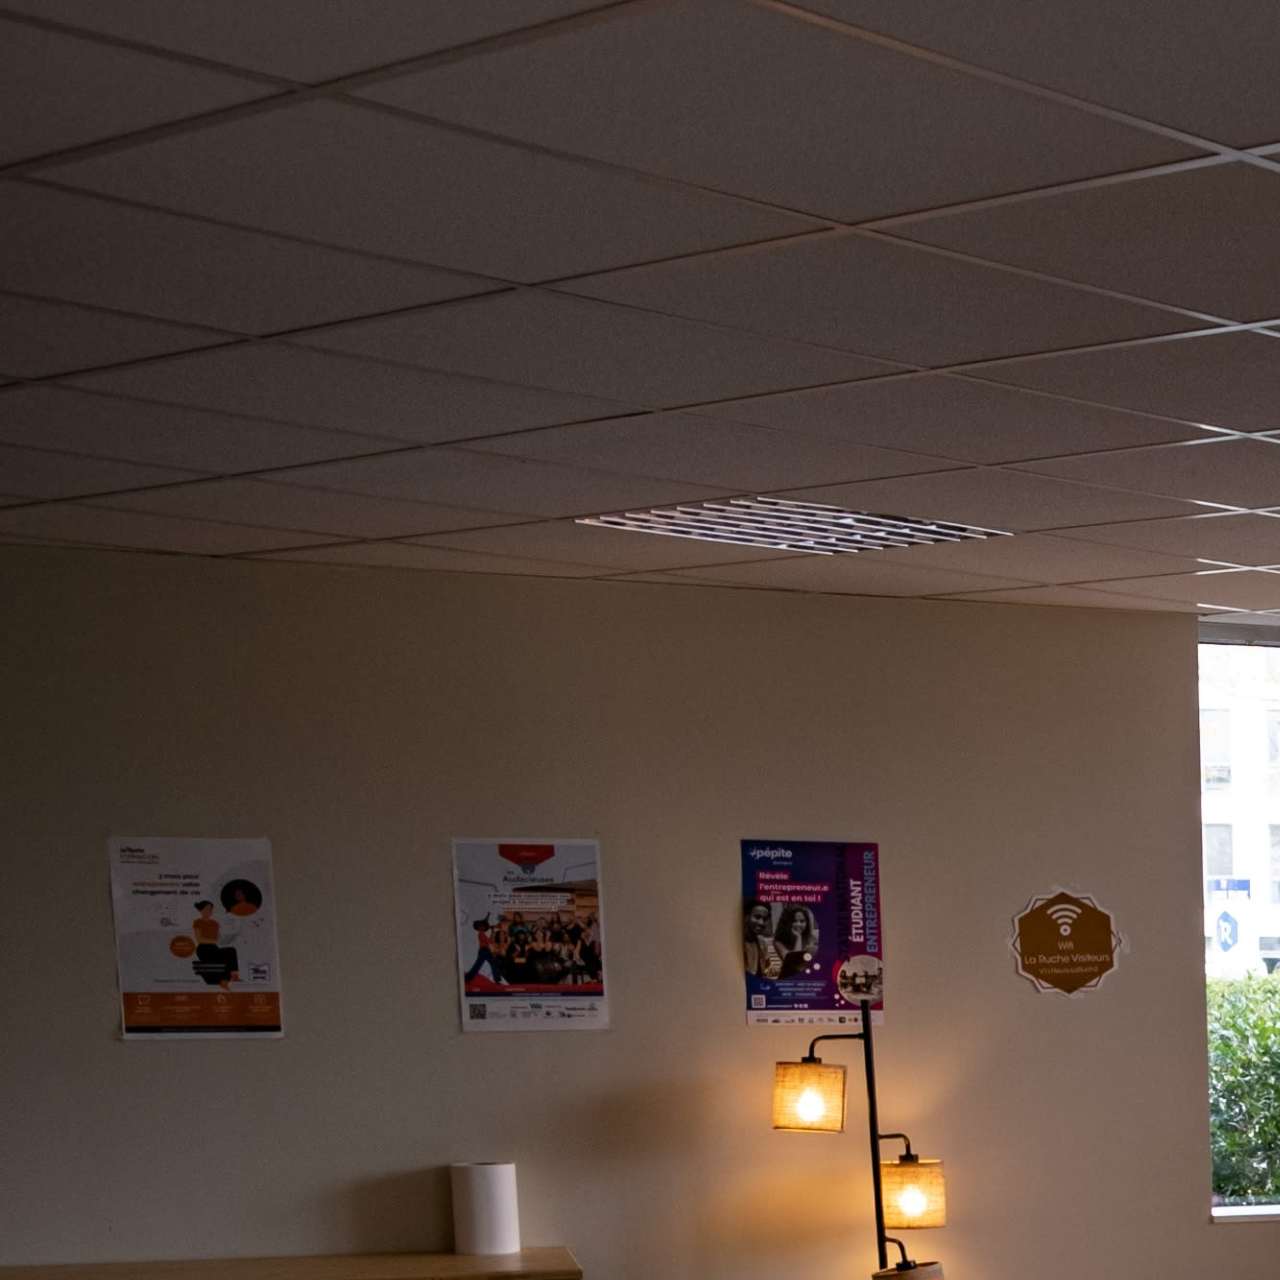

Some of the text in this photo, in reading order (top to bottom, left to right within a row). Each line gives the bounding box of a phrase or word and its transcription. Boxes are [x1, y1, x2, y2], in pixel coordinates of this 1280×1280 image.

[756, 847, 793, 859] pépite
[759, 894, 774, 903] qui
[775, 894, 789, 903] est
[848, 878, 864, 943] ÉTUDIANT
[863, 850, 879, 953] ENTREPRENEUR
